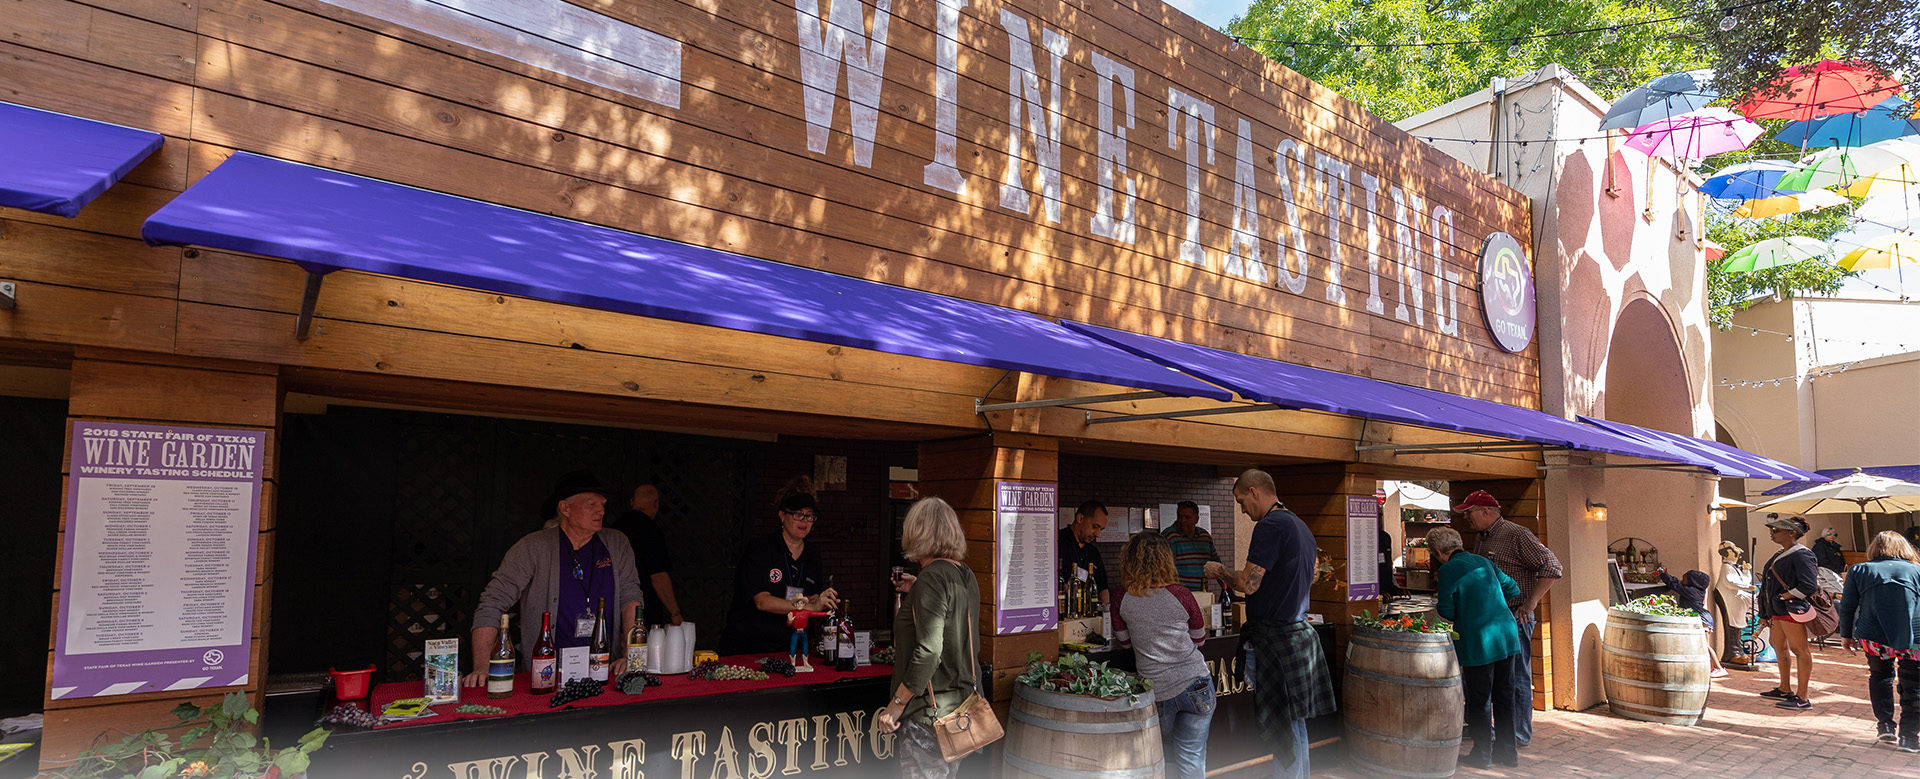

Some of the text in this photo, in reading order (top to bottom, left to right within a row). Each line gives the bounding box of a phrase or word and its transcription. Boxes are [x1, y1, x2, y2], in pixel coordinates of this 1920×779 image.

[795, 0, 1459, 337] WINE TASTING
[1496, 318, 1506, 334] GO
[82, 428, 256, 444] 2018 STATE FAIR OF TEXAS
[84, 437, 254, 470] WINE GARDEN
[80, 466, 254, 478] WINERY TASTING SCHEDULE
[1001, 490, 1054, 507] WINE GARDEN
[672, 706, 898, 779] TASTING
